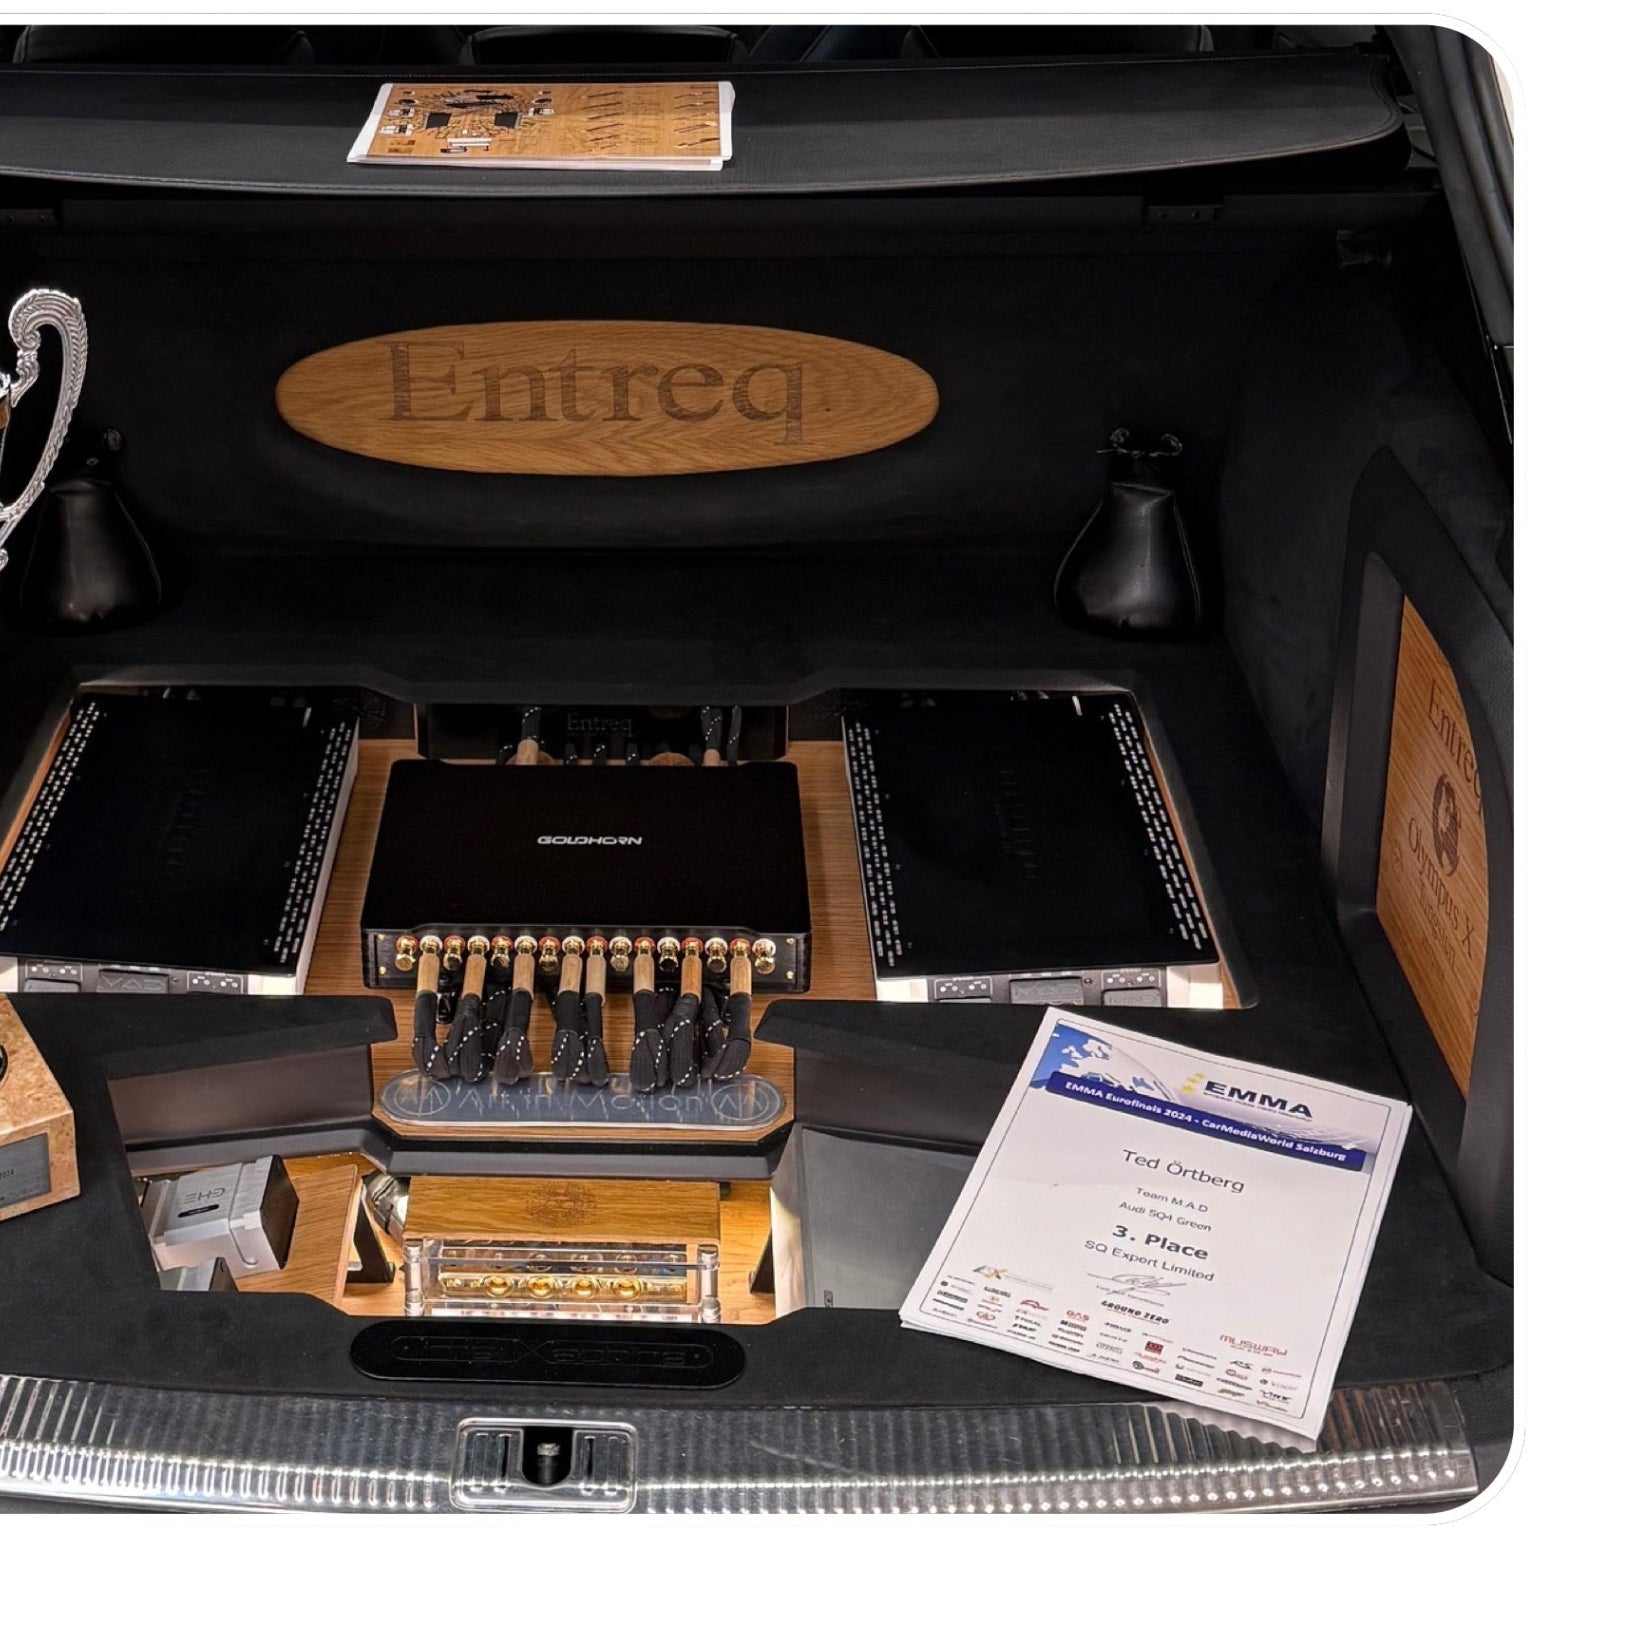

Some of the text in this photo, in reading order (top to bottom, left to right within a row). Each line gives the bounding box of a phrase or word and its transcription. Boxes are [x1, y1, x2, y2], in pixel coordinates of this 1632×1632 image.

[377, 340, 807, 447] Entreq
[537, 835, 643, 845] GOLDHORN
[1408, 817, 1459, 931] Olympus
[1204, 1079, 1314, 1119] EMMA
[1065, 1081, 1104, 1099] EMMA
[1104, 1092, 1162, 1116] Eurofinals
[1163, 1108, 1193, 1124] 2024
[1201, 1117, 1294, 1149] CarMediaWorld
[1294, 1141, 1348, 1165] Salzburg
[1122, 1149, 1246, 1195] Ted Örtberg
[1118, 1200, 1147, 1217] Audi
[1175, 1213, 1213, 1233] Green
[1084, 1239, 1109, 1255] SQ
[1112, 1224, 1210, 1261] 3. Place
[1101, 1299, 1170, 1326] GROUND ZERO
[1219, 1333, 1289, 1357] MUSWAY
